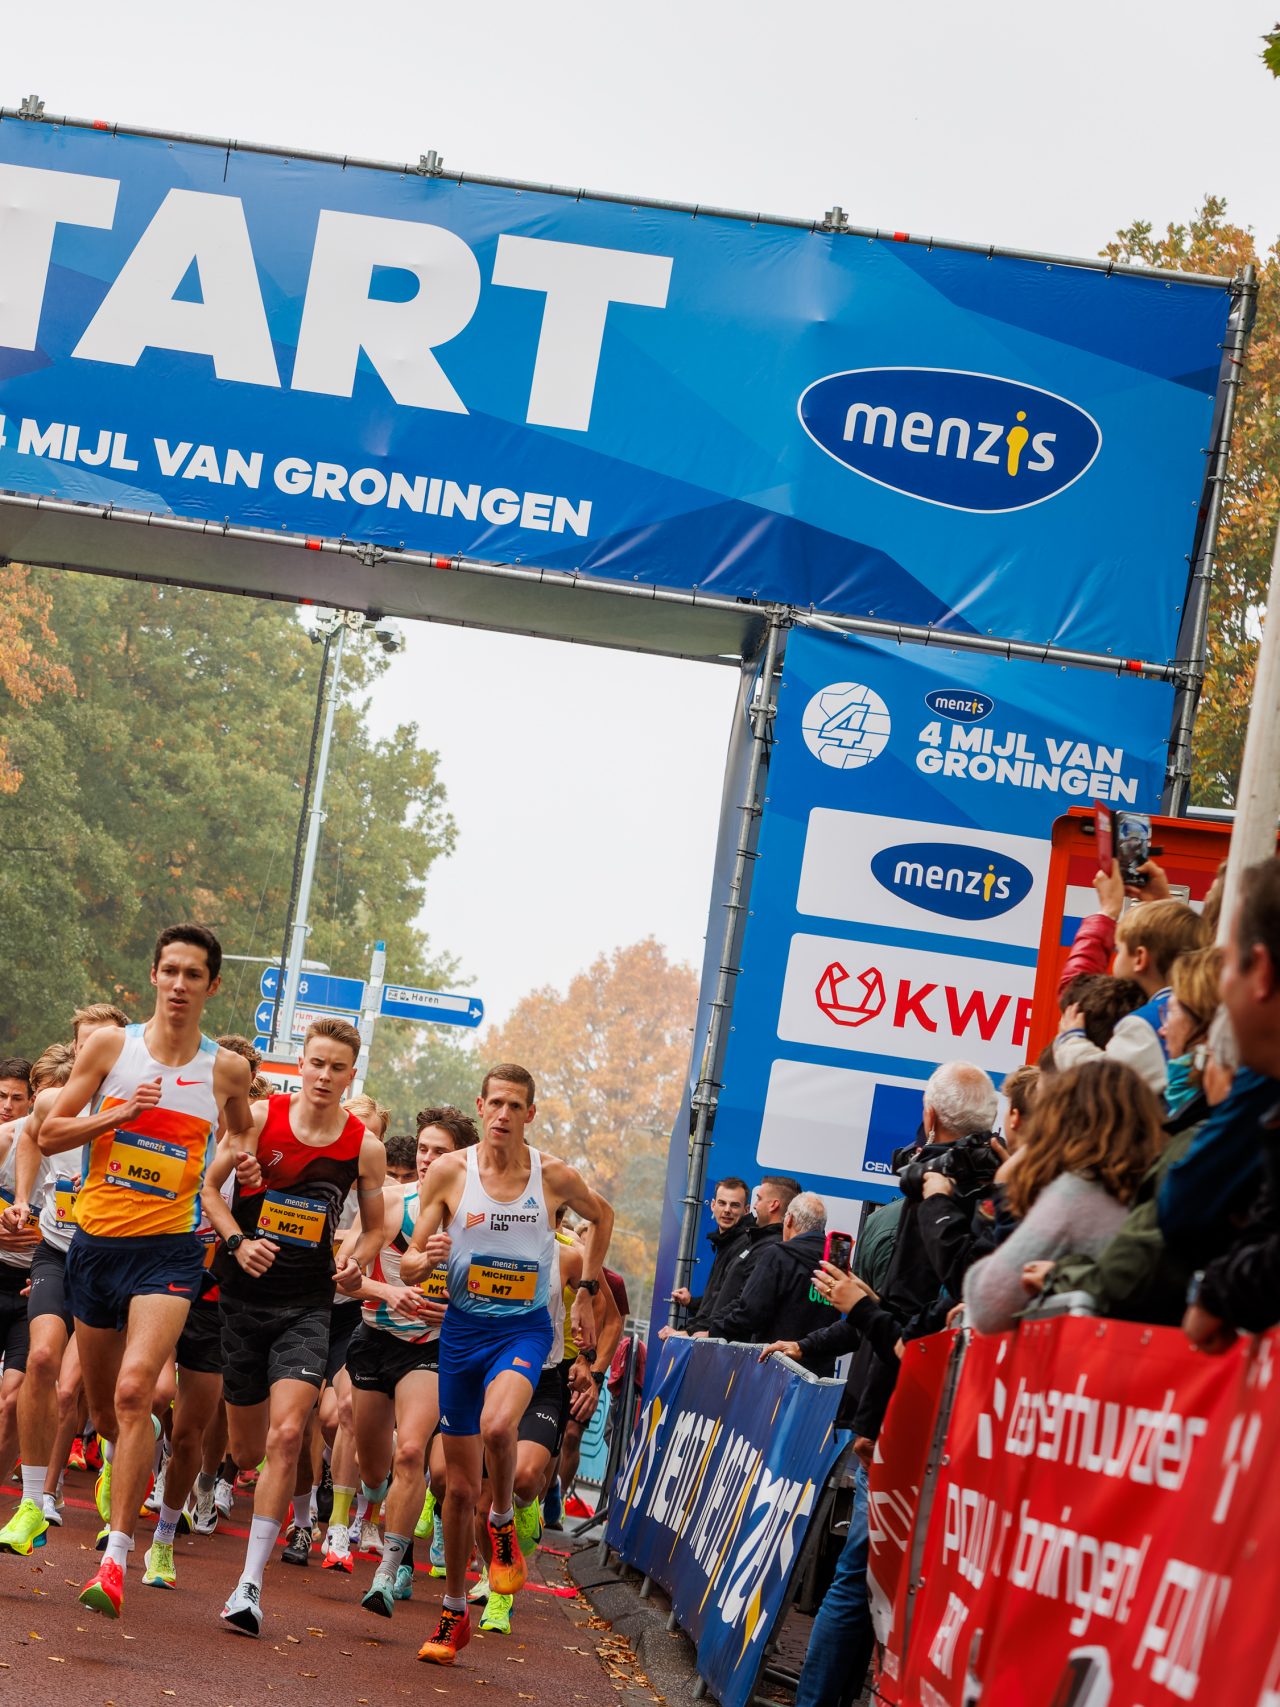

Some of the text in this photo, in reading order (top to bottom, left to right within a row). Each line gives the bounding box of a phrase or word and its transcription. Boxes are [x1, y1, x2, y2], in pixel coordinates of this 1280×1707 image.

[843, 402, 1057, 477] menzis
[19, 417, 139, 472] MIJL
[153, 438, 263, 489] VAN
[273, 457, 592, 537] GRONINGEN
[934, 696, 985, 716] menzis
[918, 721, 1124, 774] 4 MIJL VAN
[915, 747, 1139, 804] GRONINGEN
[894, 861, 1011, 902] menzis
[412, 993, 439, 1004] Haren
[137, 1138, 166, 1152] menzis
[128, 1165, 161, 1183] M30
[285, 1198, 309, 1209] menzis
[297, 1214, 319, 1222] VELDEN
[278, 1221, 304, 1235] M21
[490, 1221, 509, 1232] lab
[492, 1260, 518, 1270] menzis
[481, 1270, 525, 1282] MICHIELS
[428, 1284, 448, 1295] M1
[491, 1284, 512, 1296] M7
